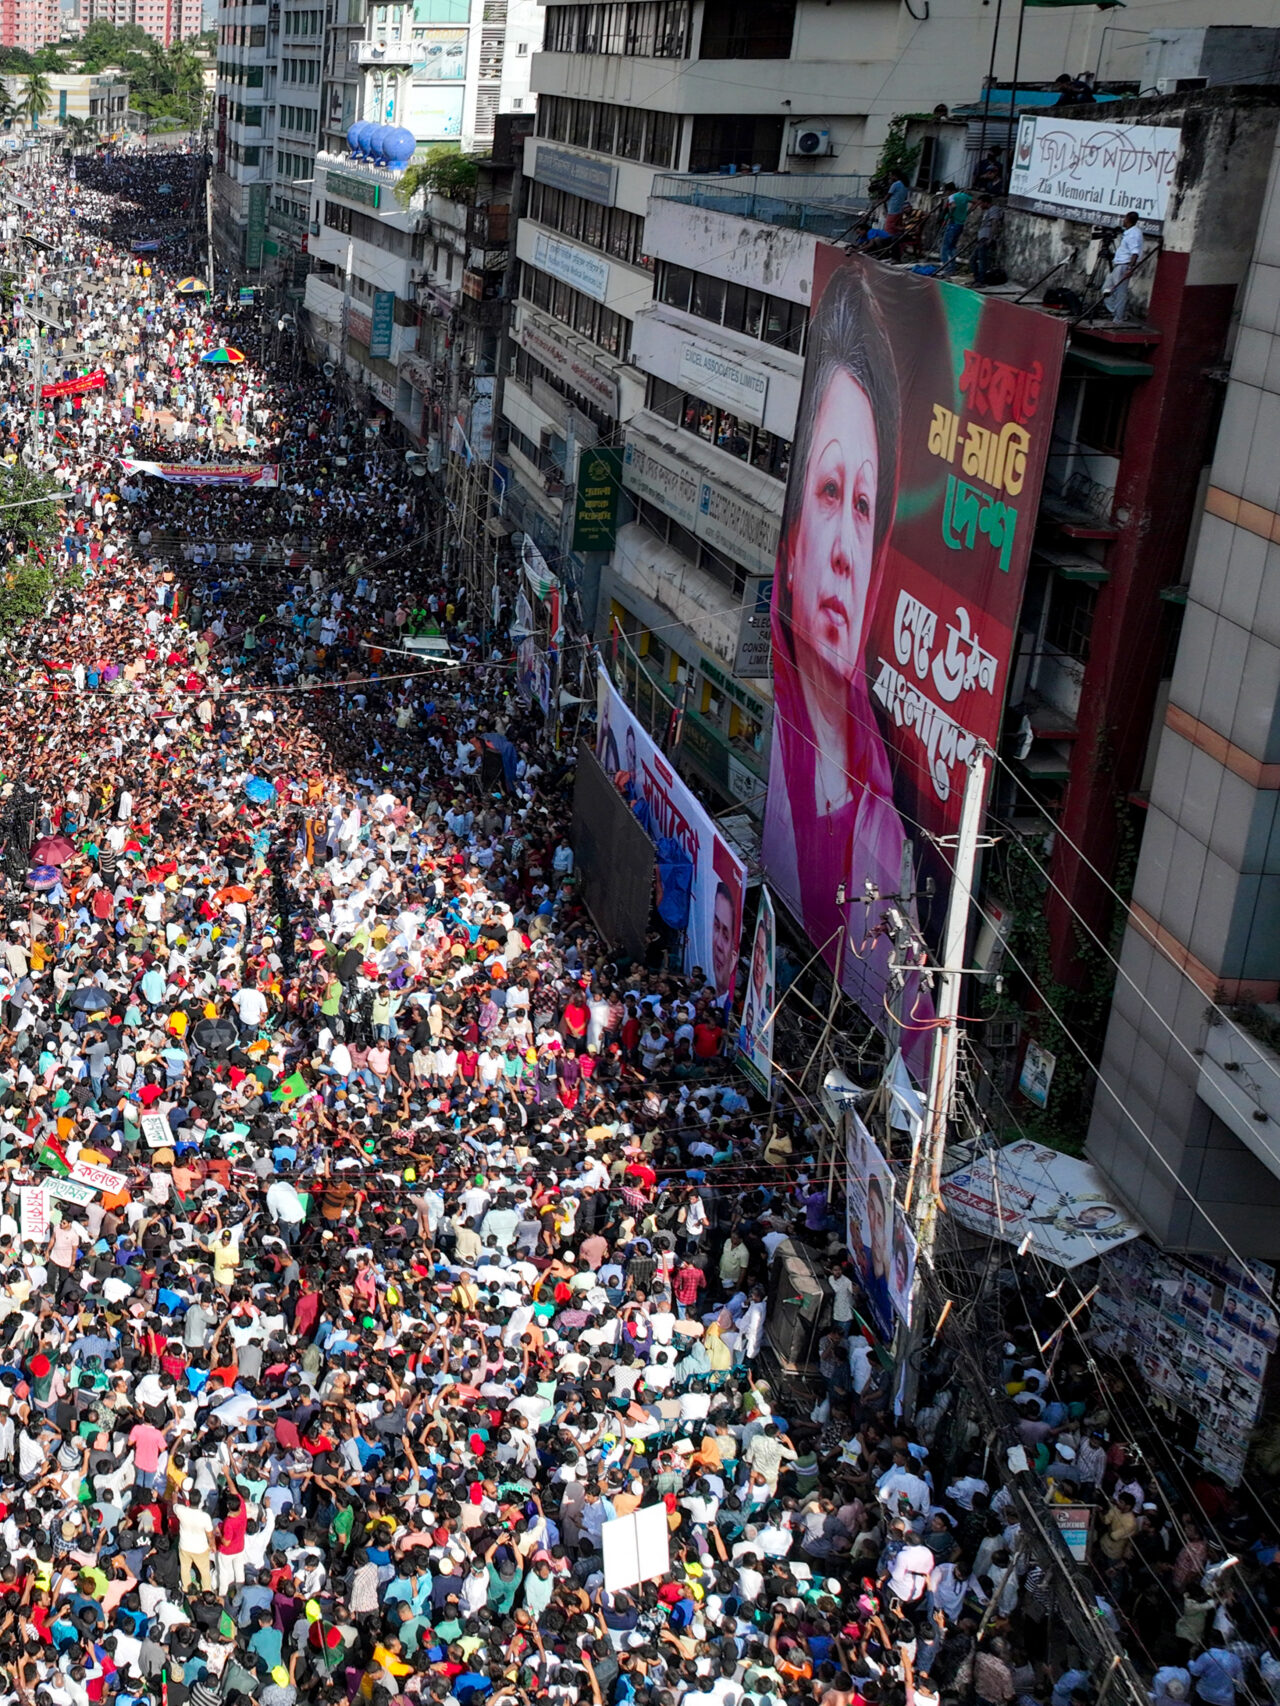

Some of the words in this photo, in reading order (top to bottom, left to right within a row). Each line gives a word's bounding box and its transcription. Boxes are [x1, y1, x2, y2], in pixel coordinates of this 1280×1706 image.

[1037, 178, 1051, 194] Zia
[1056, 181, 1104, 203] Memorial
[1109, 189, 1157, 215] Library
[685, 349, 702, 367] EXCEL
[703, 357, 739, 382] ASSOCIATES
[740, 372, 764, 393] LIMITED
[928, 403, 1032, 497] মা-মাটি
[941, 472, 1018, 573] দেশ
[78, 1164, 121, 1190] কলেজ
